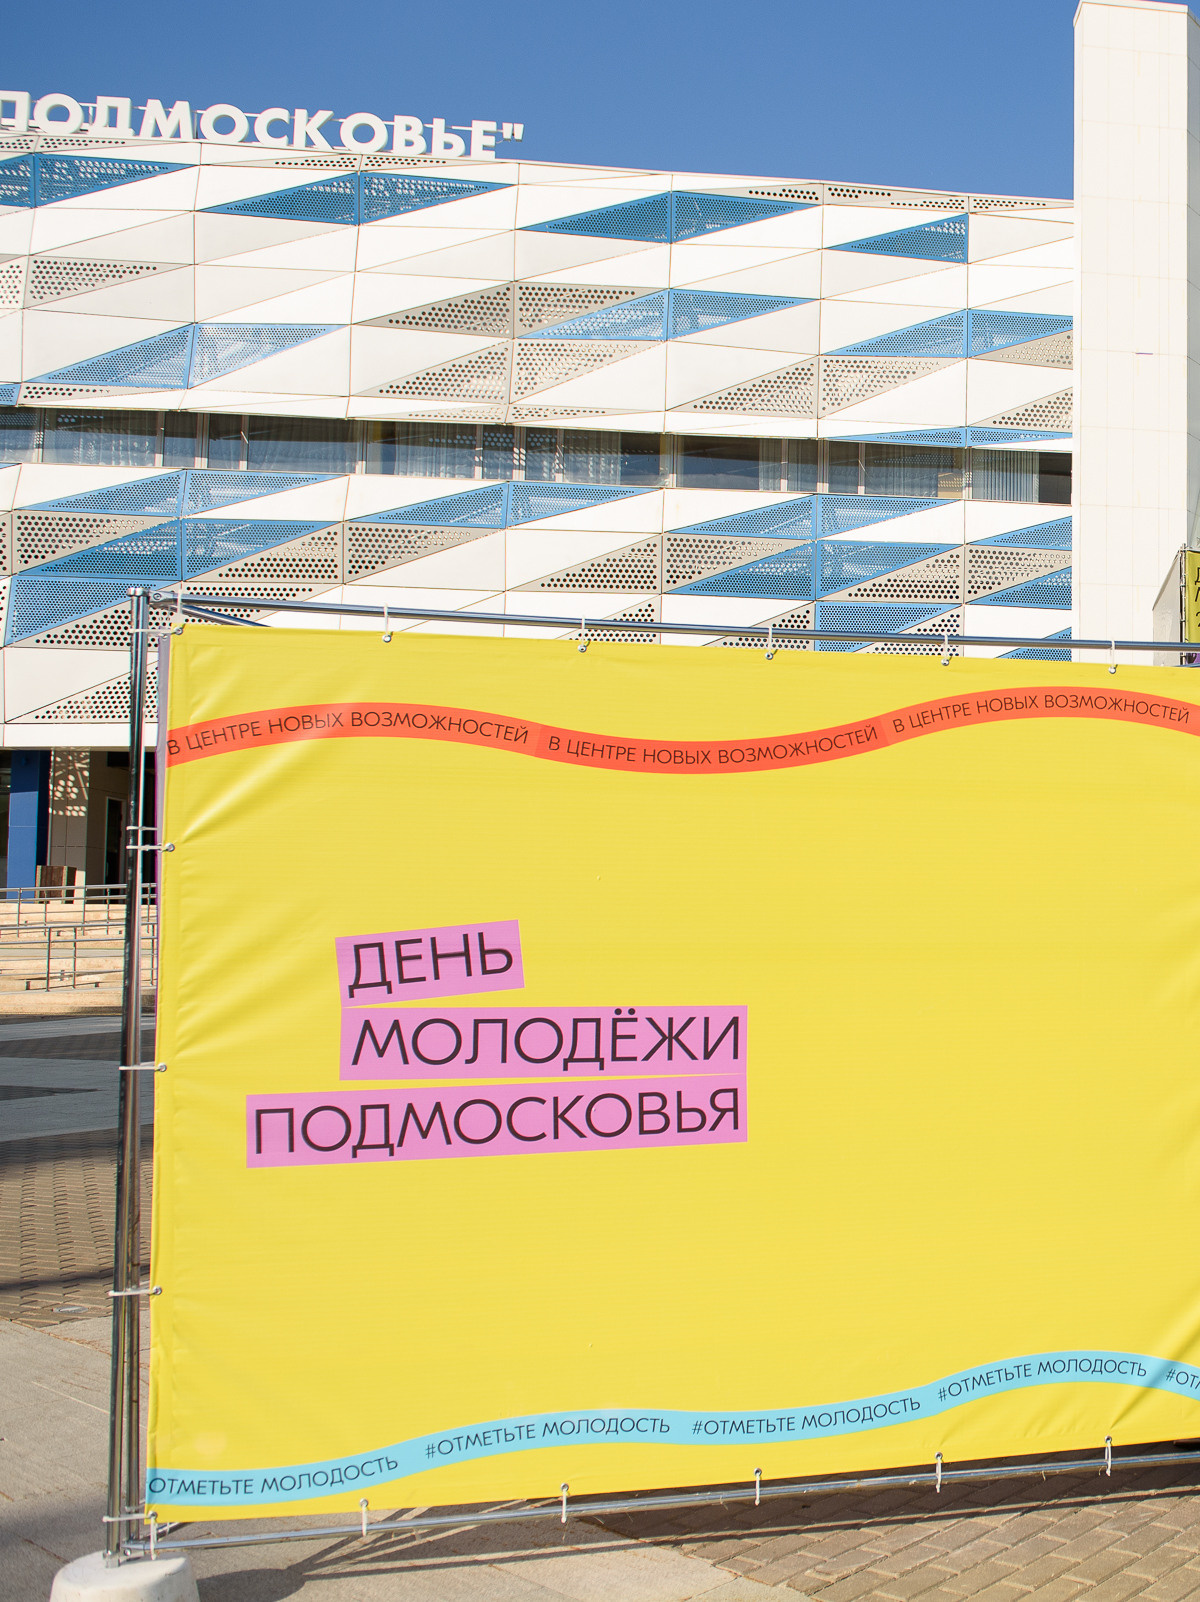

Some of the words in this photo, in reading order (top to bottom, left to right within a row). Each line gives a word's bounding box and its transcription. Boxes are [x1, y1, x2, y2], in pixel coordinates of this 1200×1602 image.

[167, 739, 181, 756] В
[187, 720, 262, 751] ЦЕНТРЕ
[268, 711, 344, 734] НОВЫХ
[351, 711, 529, 744] ВОЗМОЖНОСТЕЙ
[892, 718, 905, 733] В
[910, 704, 972, 729] ЦЕНТРЕ
[977, 694, 1040, 714] НОВЫХ
[1044, 694, 1189, 724] ВОЗМОЖНОСТЕЙ
[548, 736, 560, 751] В
[567, 739, 636, 762] ЦЕНТРЕ
[643, 748, 712, 765] НОВЫХ
[719, 726, 878, 764] ВОЗМОЖНОСТЕЙ
[348, 931, 513, 998] ДЕНЬ
[351, 1007, 740, 1071] МОЛОДЁЖИ
[255, 1087, 739, 1158] ПОДМОСКОВЬЯ
[937, 1363, 1032, 1402] #ОТМЕТЬТЕ
[1037, 1358, 1147, 1377] МОЛОДОСТЬ
[425, 1424, 535, 1459] #ОТМЕТЬТЕ
[542, 1417, 670, 1438] МОЛОДОСТЬ
[692, 1417, 795, 1436] #ОТМЕТЬТЕ
[802, 1397, 921, 1431] МОЛОДОСТЬ
[260, 1456, 398, 1494] МОЛОДОСТЬ
